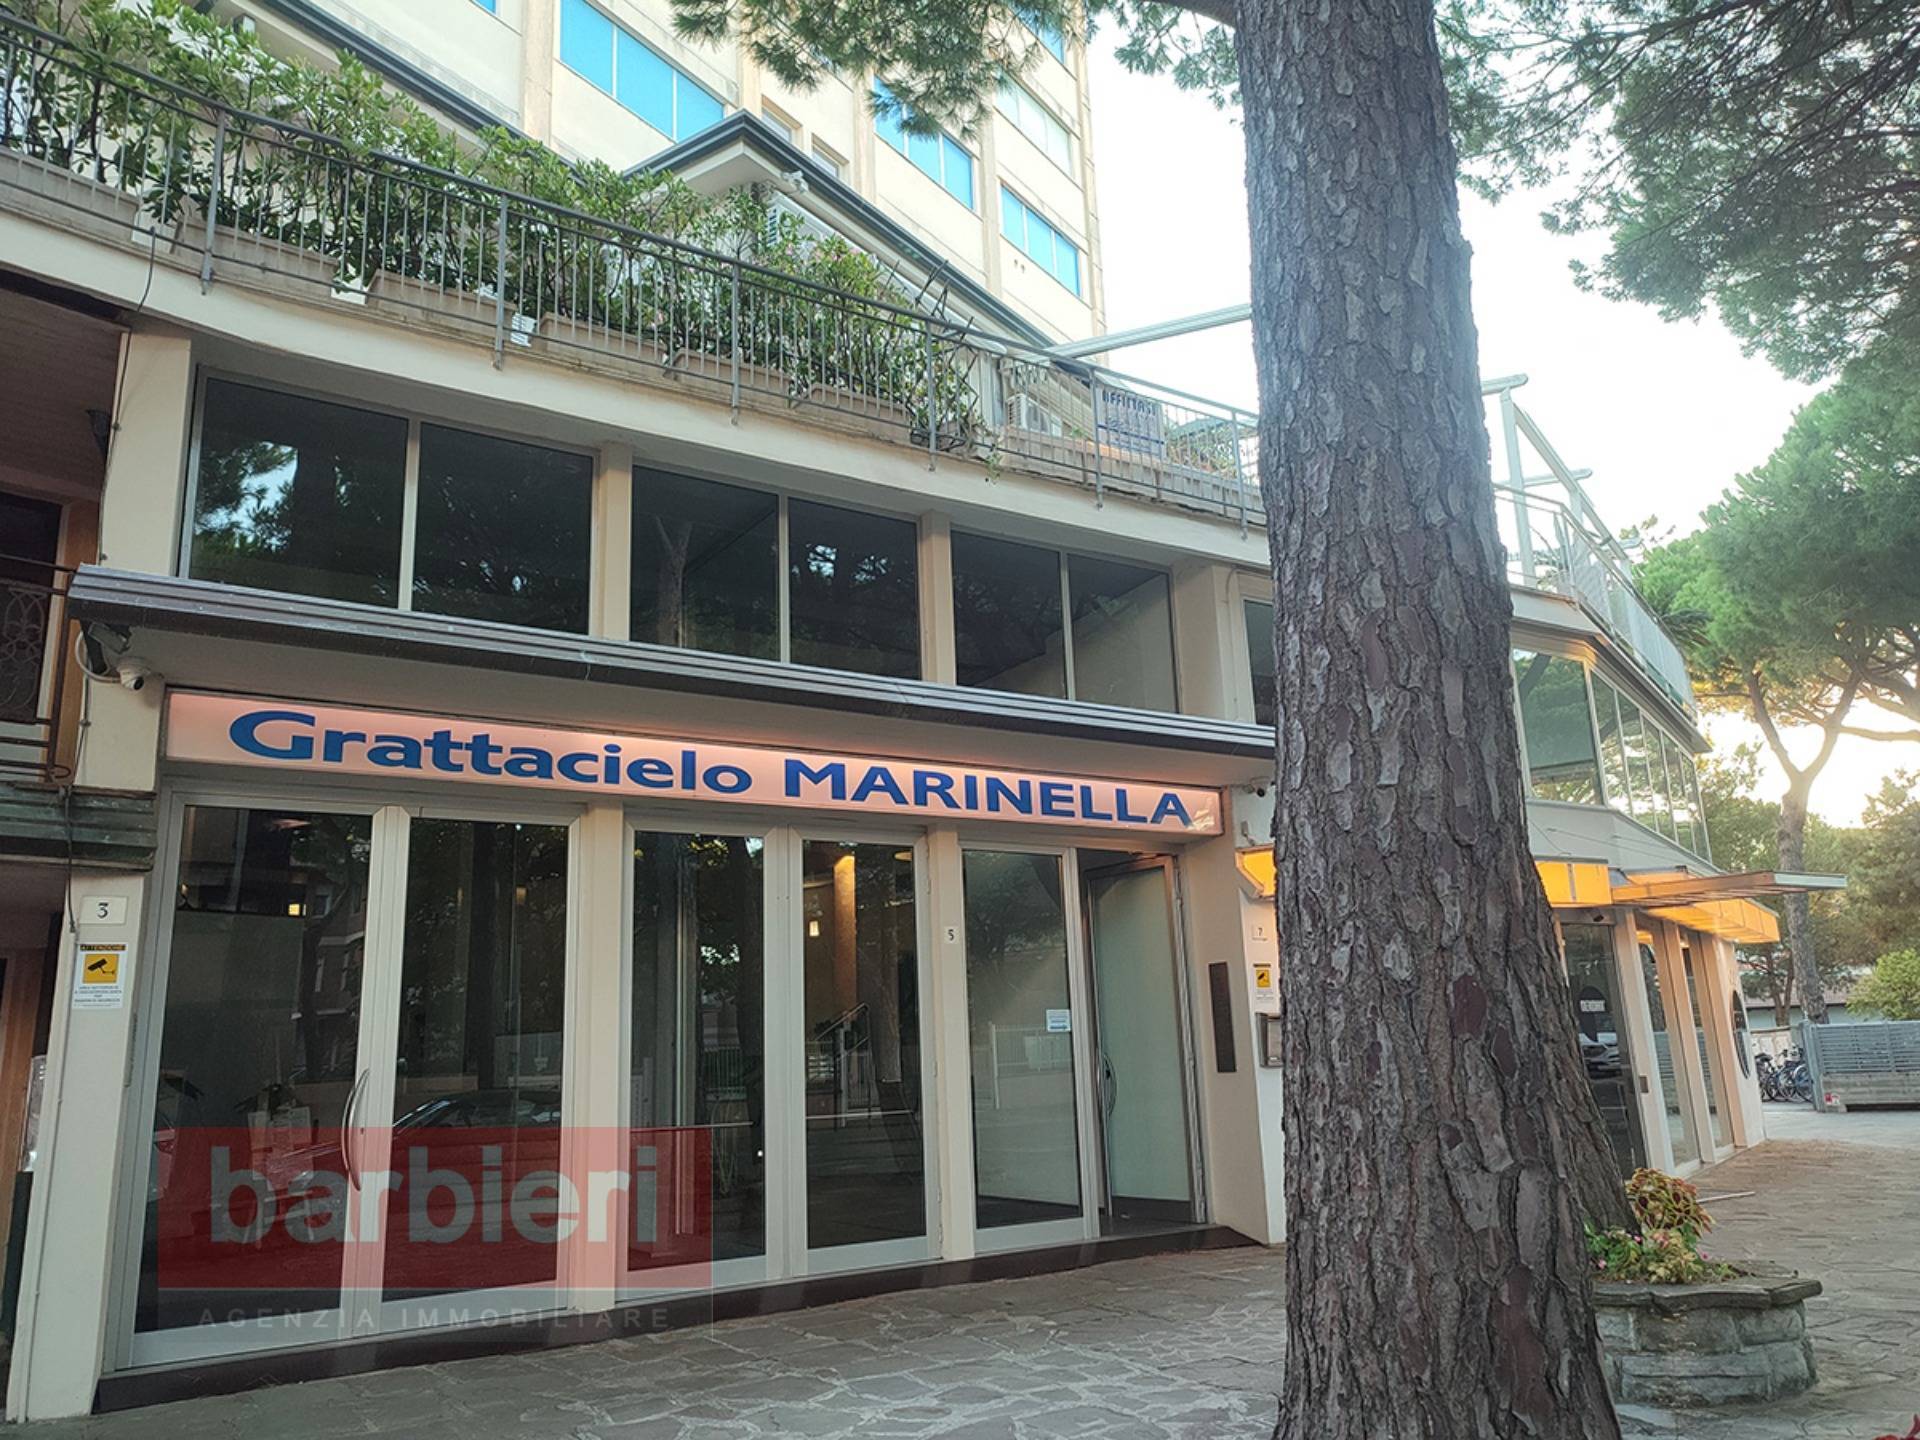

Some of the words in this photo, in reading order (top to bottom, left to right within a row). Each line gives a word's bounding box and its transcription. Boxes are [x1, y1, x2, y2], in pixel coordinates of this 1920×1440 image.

[229, 710, 753, 794] Grattacielo
[784, 759, 1193, 828] MARINELLA
[97, 902, 109, 918] 3
[948, 929, 955, 941] 5
